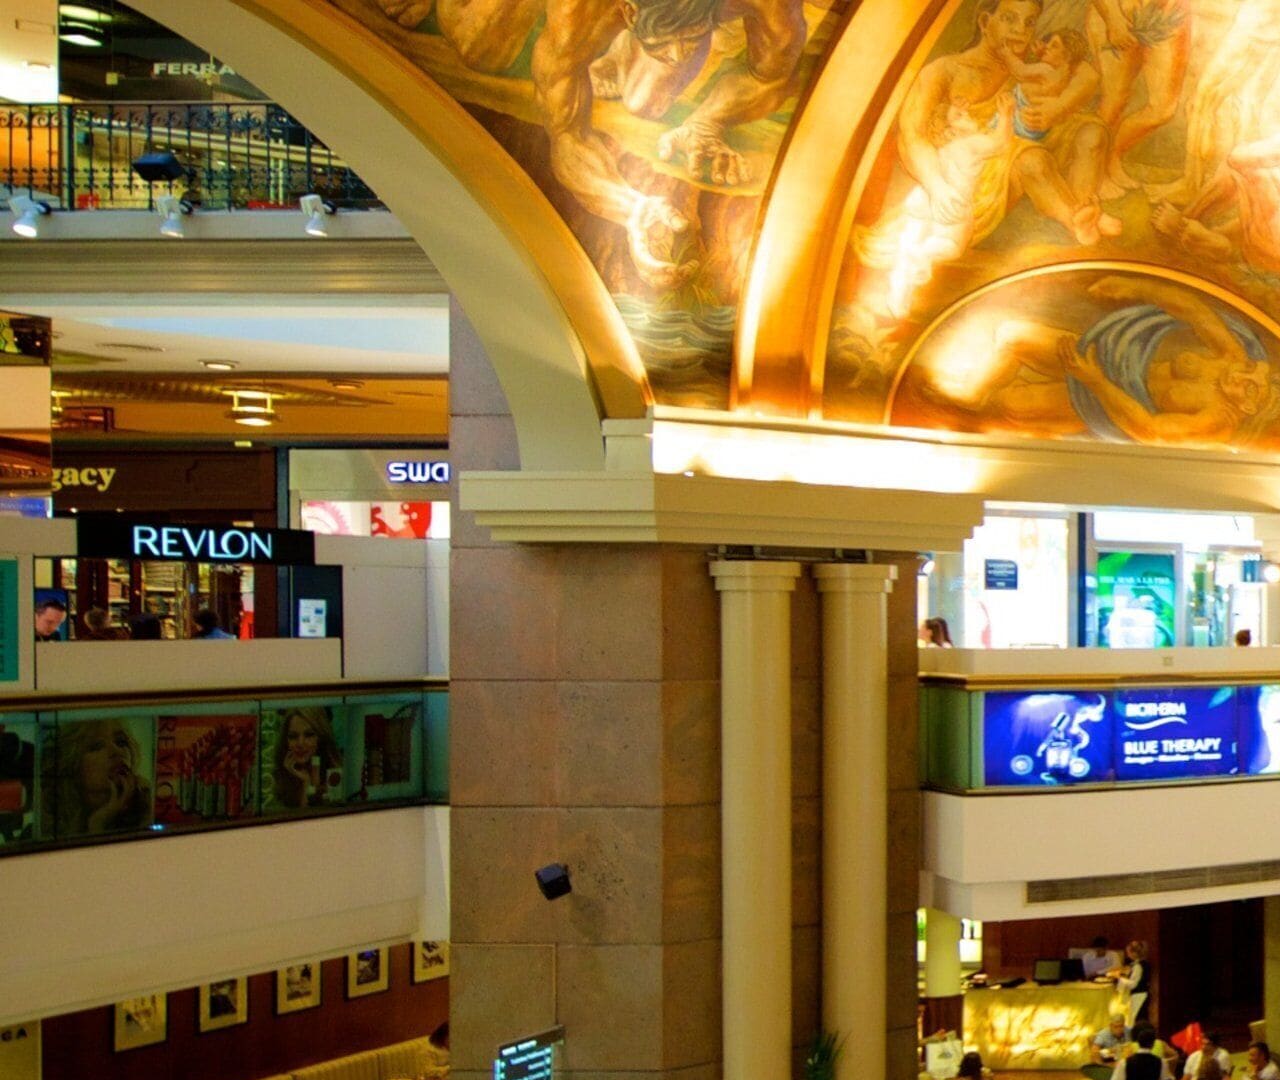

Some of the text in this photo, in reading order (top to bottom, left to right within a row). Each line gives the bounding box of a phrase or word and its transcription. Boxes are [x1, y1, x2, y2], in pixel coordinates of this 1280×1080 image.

[133, 525, 272, 559] REVLON
[1124, 738, 1222, 755] BLUE THERAPY
